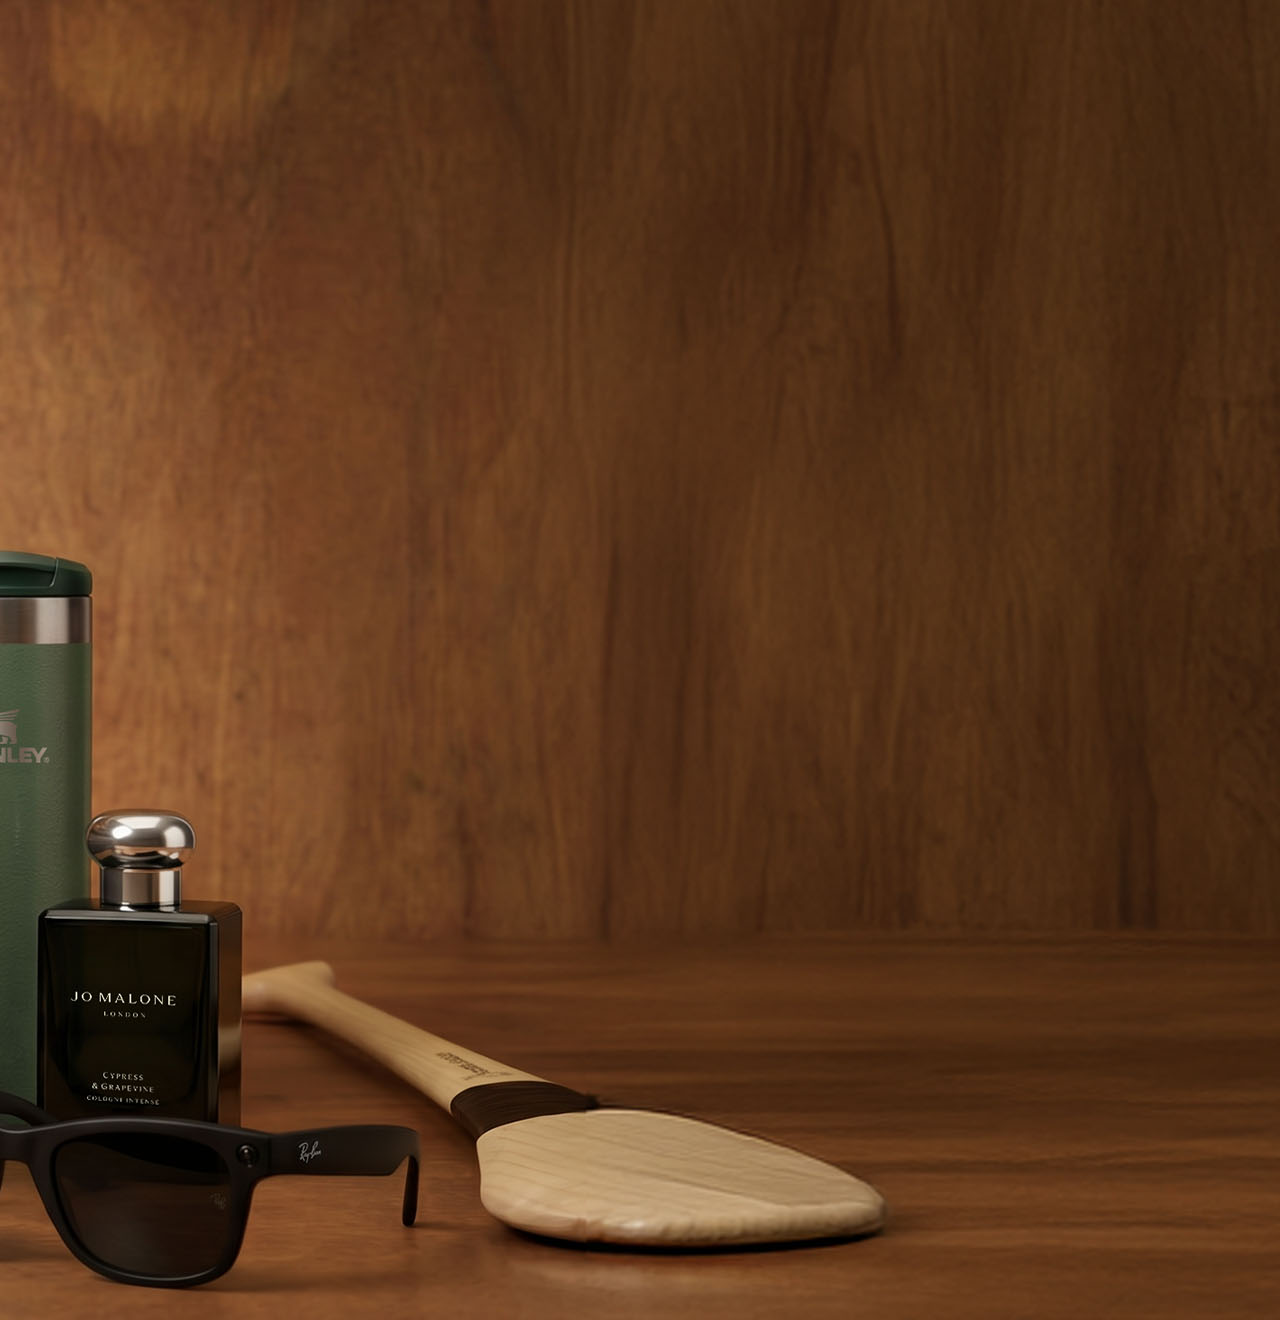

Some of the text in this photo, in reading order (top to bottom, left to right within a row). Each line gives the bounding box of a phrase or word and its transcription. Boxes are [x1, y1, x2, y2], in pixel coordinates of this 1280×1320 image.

[70, 991, 177, 1007] JO MALONE
[103, 1010, 146, 1019] LONDON
[102, 1071, 144, 1081] CYPRESS
[91, 1082, 156, 1093] & GRAPEVINE
[86, 1094, 160, 1106] COLOGNE INTENSE
